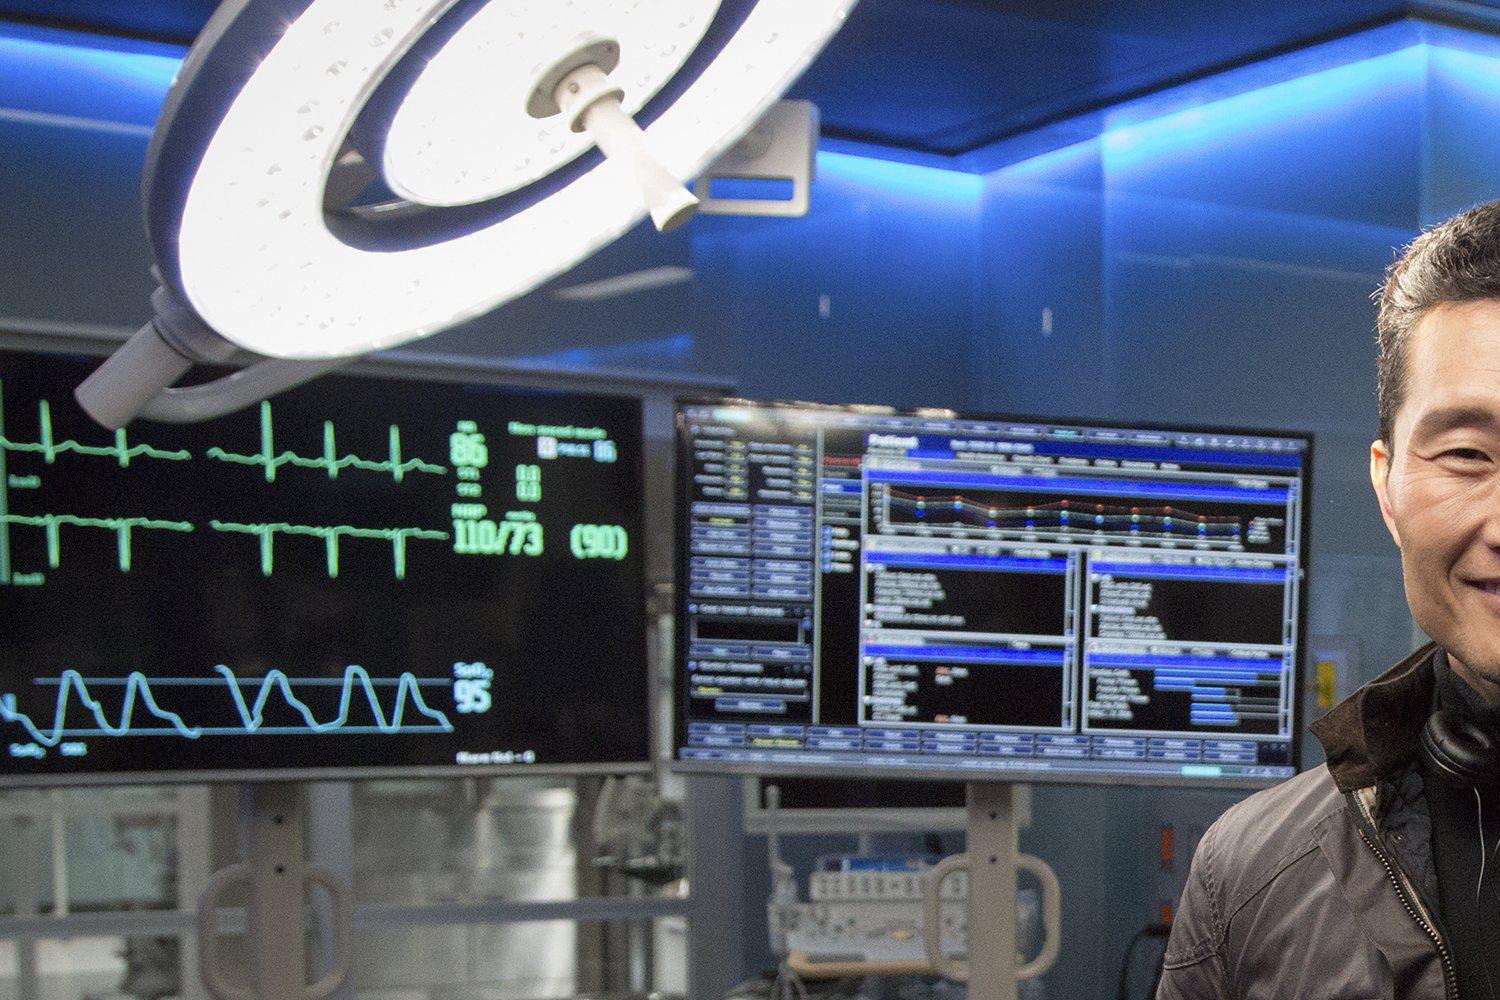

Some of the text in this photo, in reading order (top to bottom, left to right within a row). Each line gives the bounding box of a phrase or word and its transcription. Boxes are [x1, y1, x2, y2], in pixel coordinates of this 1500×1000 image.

[450, 432, 488, 468] 86
[452, 519, 629, 560] 110/73 (90)
[453, 679, 492, 714] 95
